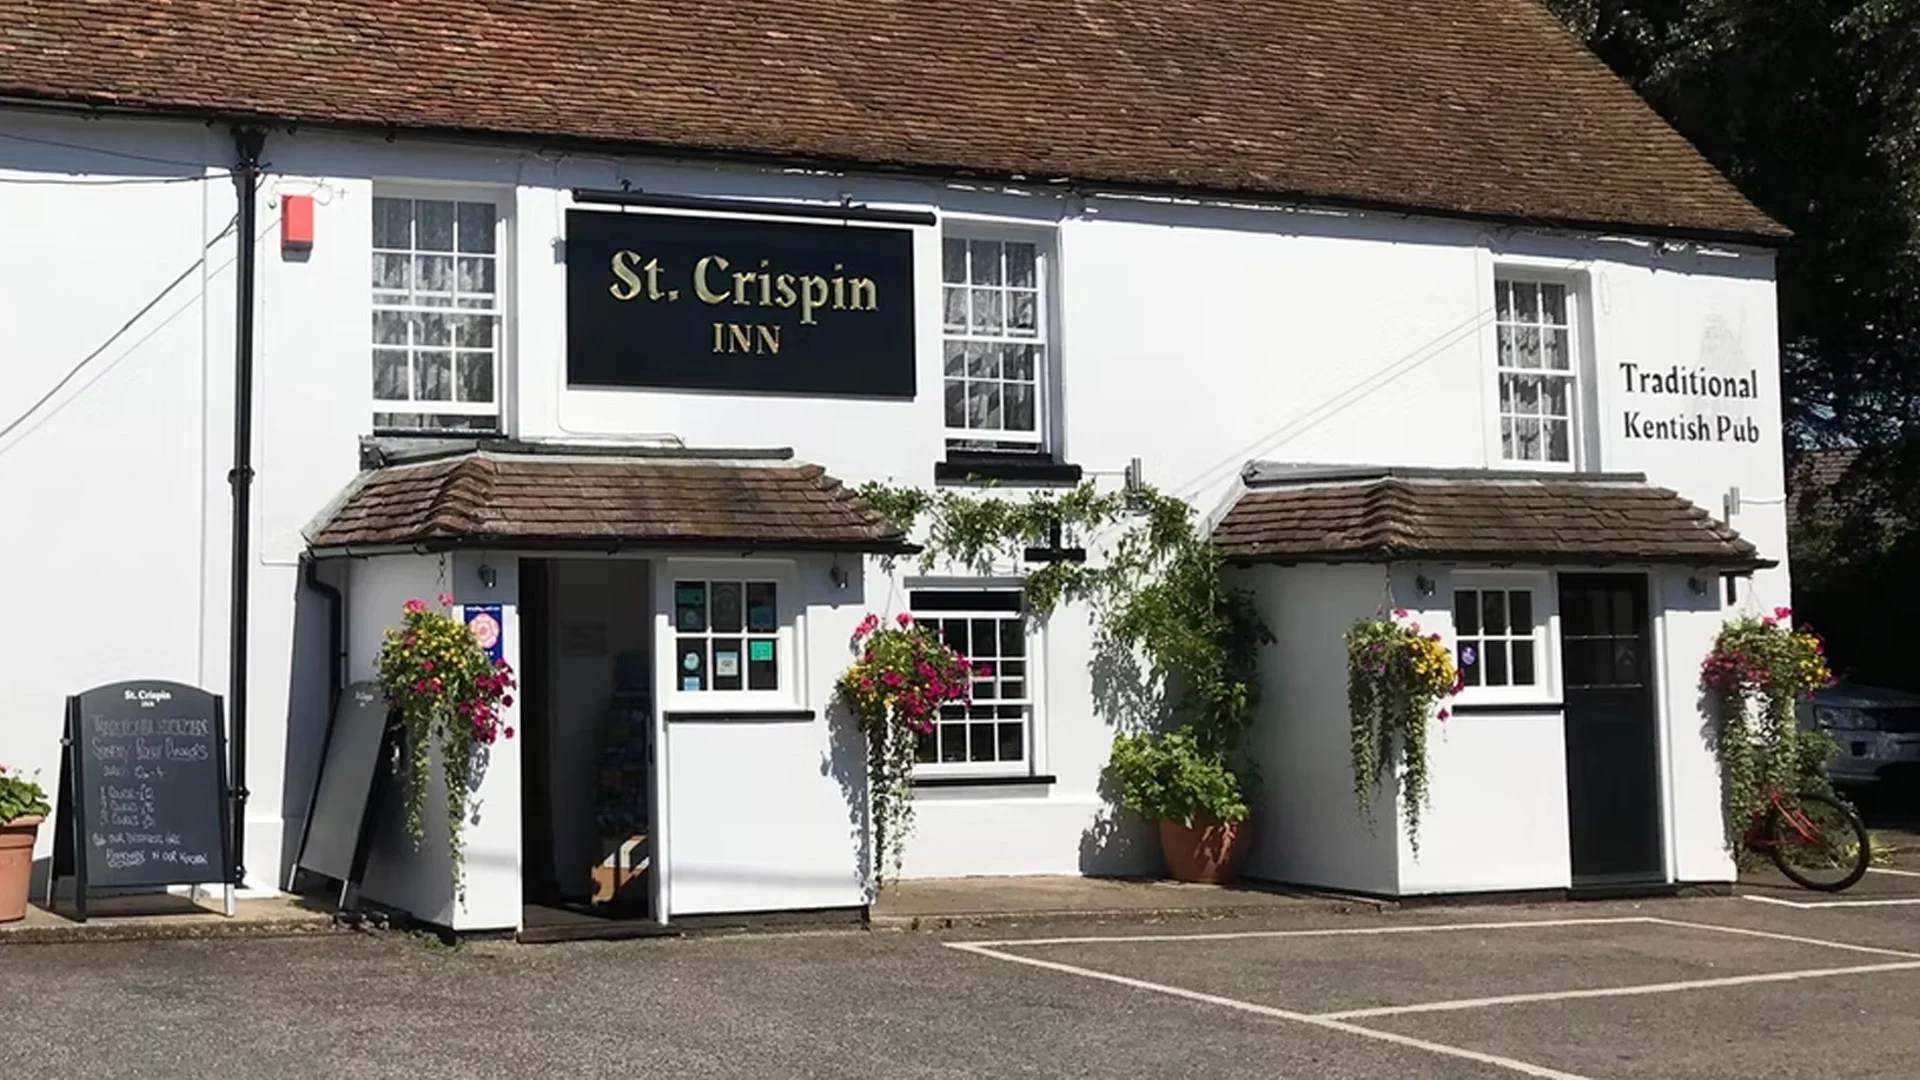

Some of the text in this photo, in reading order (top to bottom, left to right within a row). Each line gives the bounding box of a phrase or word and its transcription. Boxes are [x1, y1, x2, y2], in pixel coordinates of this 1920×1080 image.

[609, 250, 879, 325] St. Crispin
[712, 322, 781, 354] INN
[1619, 362, 1758, 399] Traditional
[1624, 411, 1760, 443] Kentish Pub
[138, 689, 172, 703] Crispin
